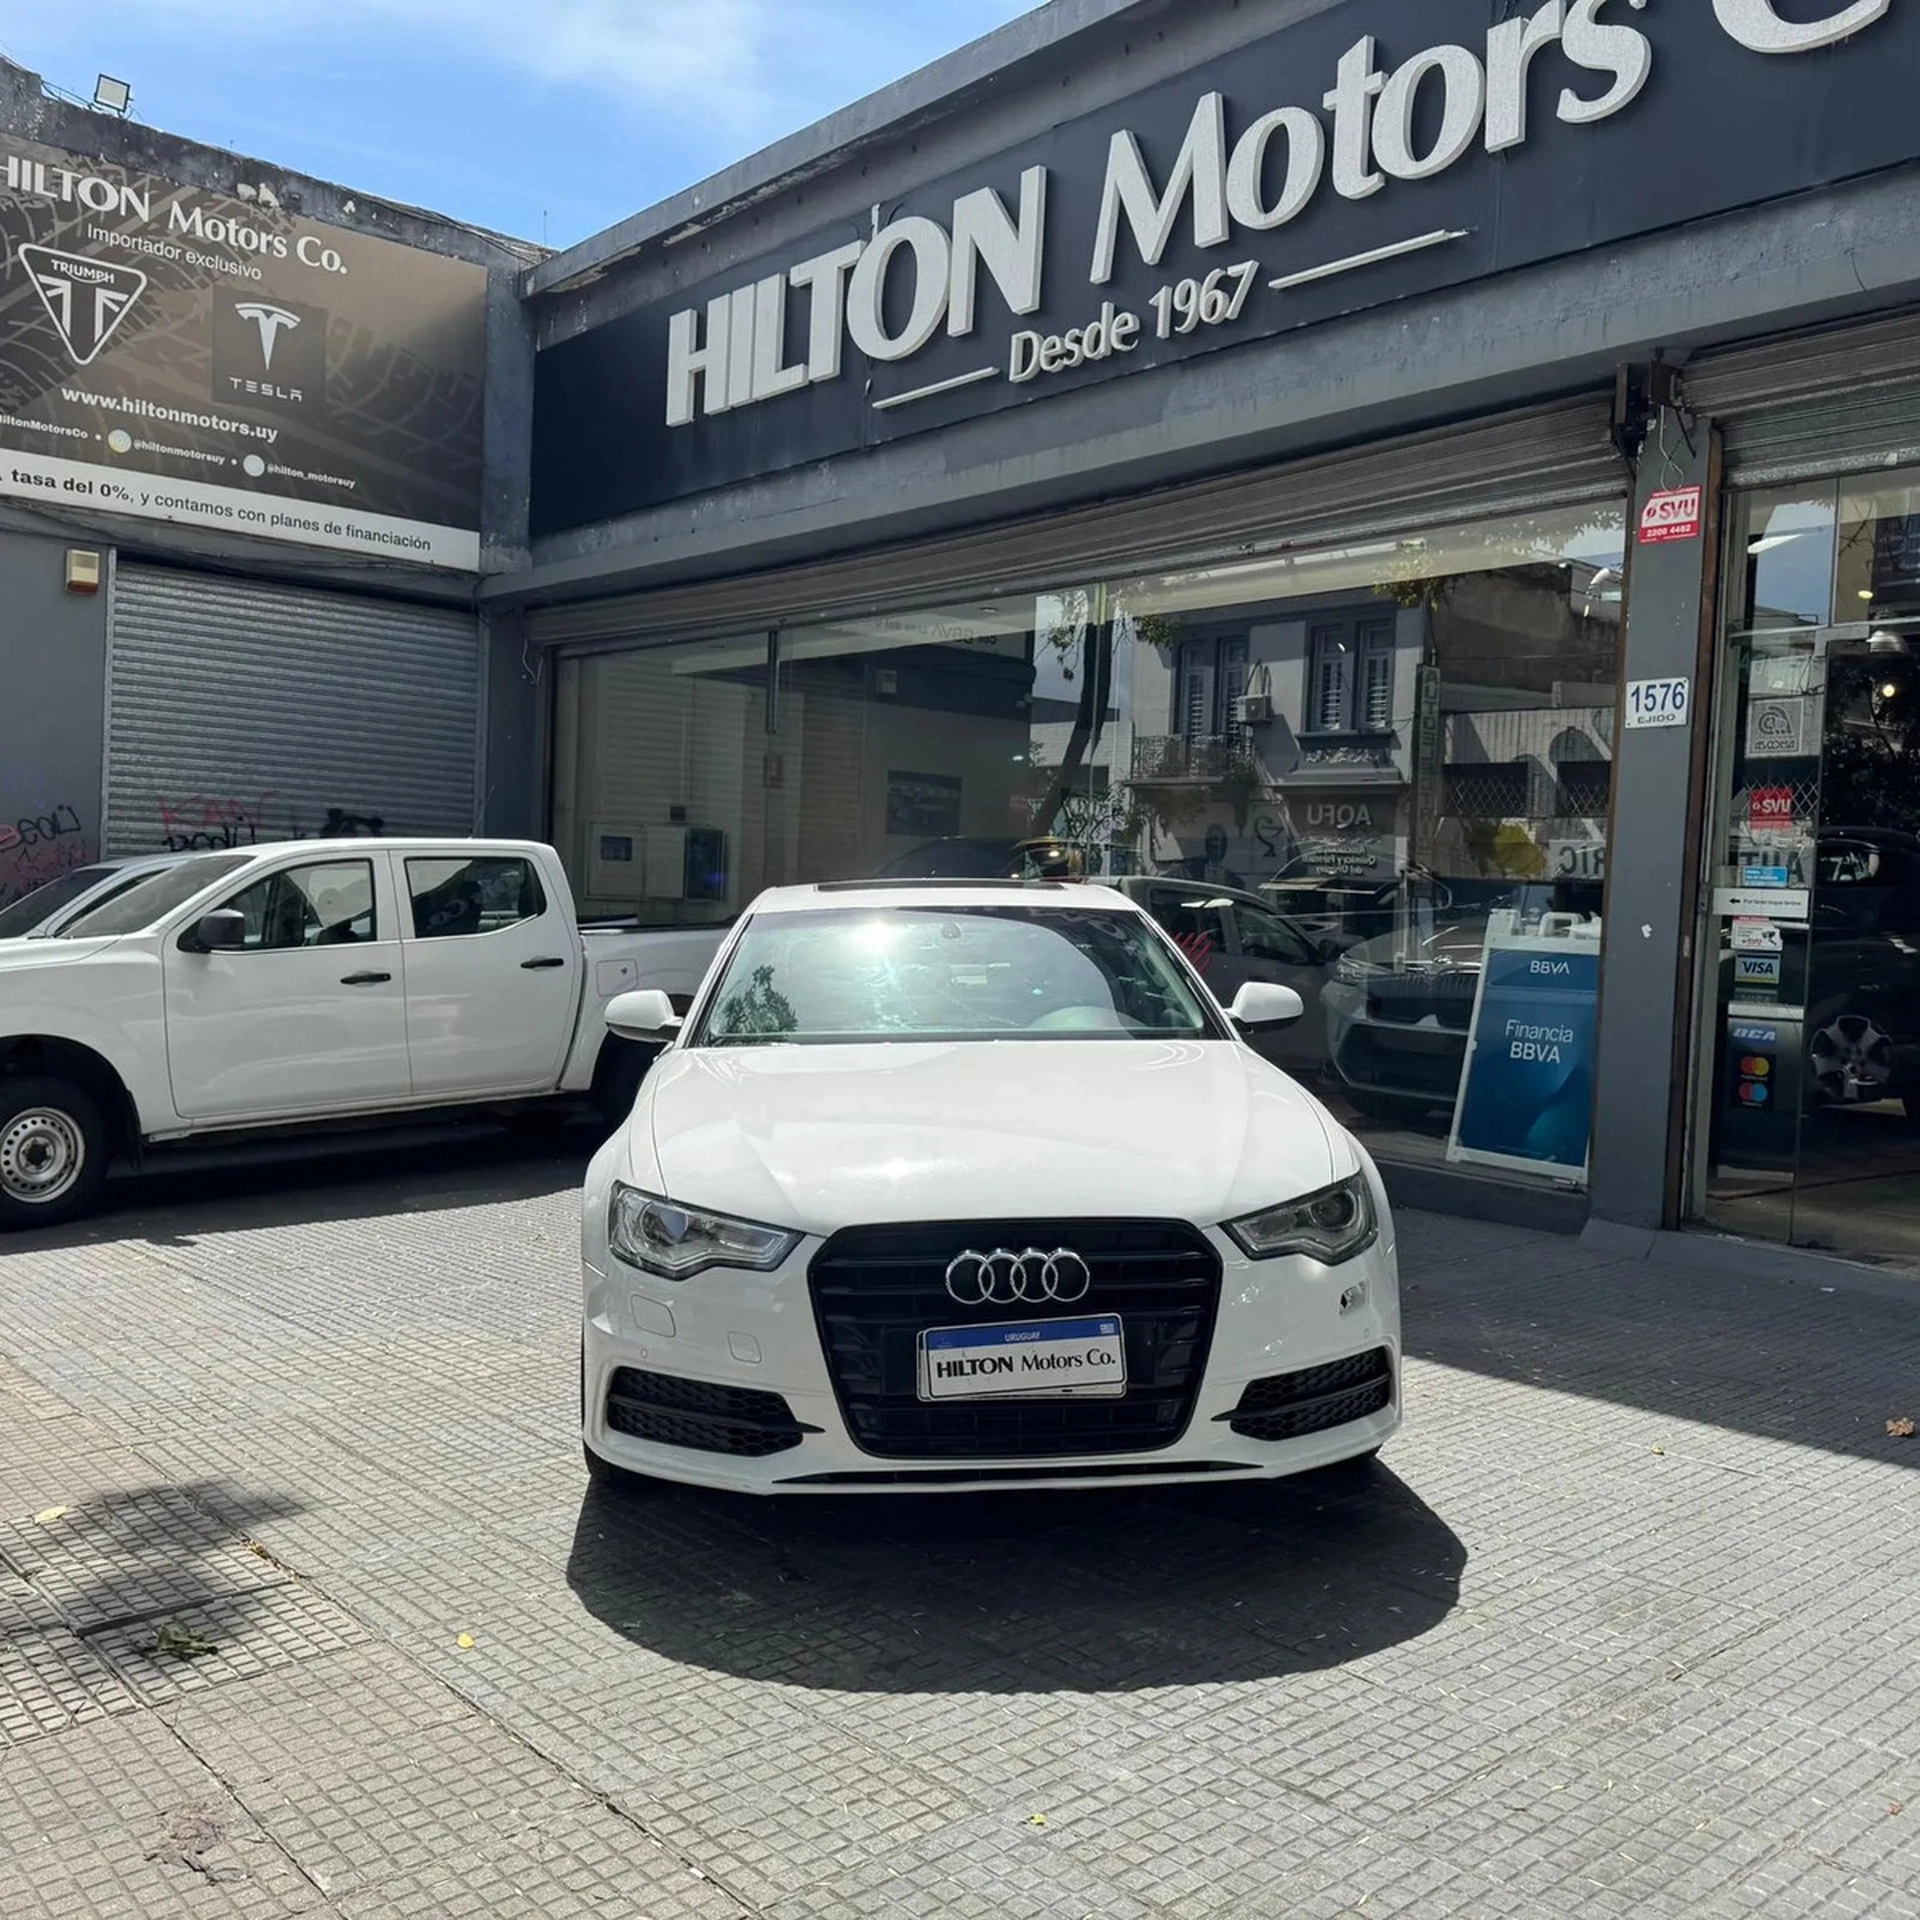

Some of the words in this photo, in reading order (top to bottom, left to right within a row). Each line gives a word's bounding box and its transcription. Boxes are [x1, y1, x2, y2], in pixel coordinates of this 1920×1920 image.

[666, 165, 1047, 427] HILTON
[1089, 0, 1652, 284] Motors
[168, 200, 288, 258] Motors
[296, 236, 348, 275] Co.
[87, 223, 182, 260] Importador
[185, 250, 262, 280] exclusivo
[51, 259, 115, 284] TRIUMPH
[1009, 301, 1140, 383] Desde
[1149, 259, 1260, 340] 1967
[229, 377, 303, 402] TESLA
[61, 388, 278, 443] www.hiltonmotors.uy
[11, 468, 57, 489] tasa
[63, 477, 94, 494] del
[100, 483, 134, 503] 0%,
[140, 493, 150, 507] y
[154, 494, 233, 518] contamos
[238, 508, 266, 523] con
[270, 513, 320, 531] planes
[324, 521, 342, 535] de
[346, 524, 431, 551] financiación
[1659, 498, 1696, 520] SVU
[1630, 681, 1685, 713] 1576
[1637, 713, 1676, 724] EJIDO
[1761, 798, 1792, 813] SVU
[1529, 959, 1570, 975] BBVA
[1742, 961, 1774, 974] VISA
[1505, 1018, 1574, 1044] Financia
[1509, 1040, 1561, 1064] BBVA
[1004, 1331, 1041, 1342] URUGUAY
[936, 1355, 1014, 1378] HILTON
[1021, 1352, 1083, 1372] Motors
[1086, 1348, 1116, 1366] Co.
